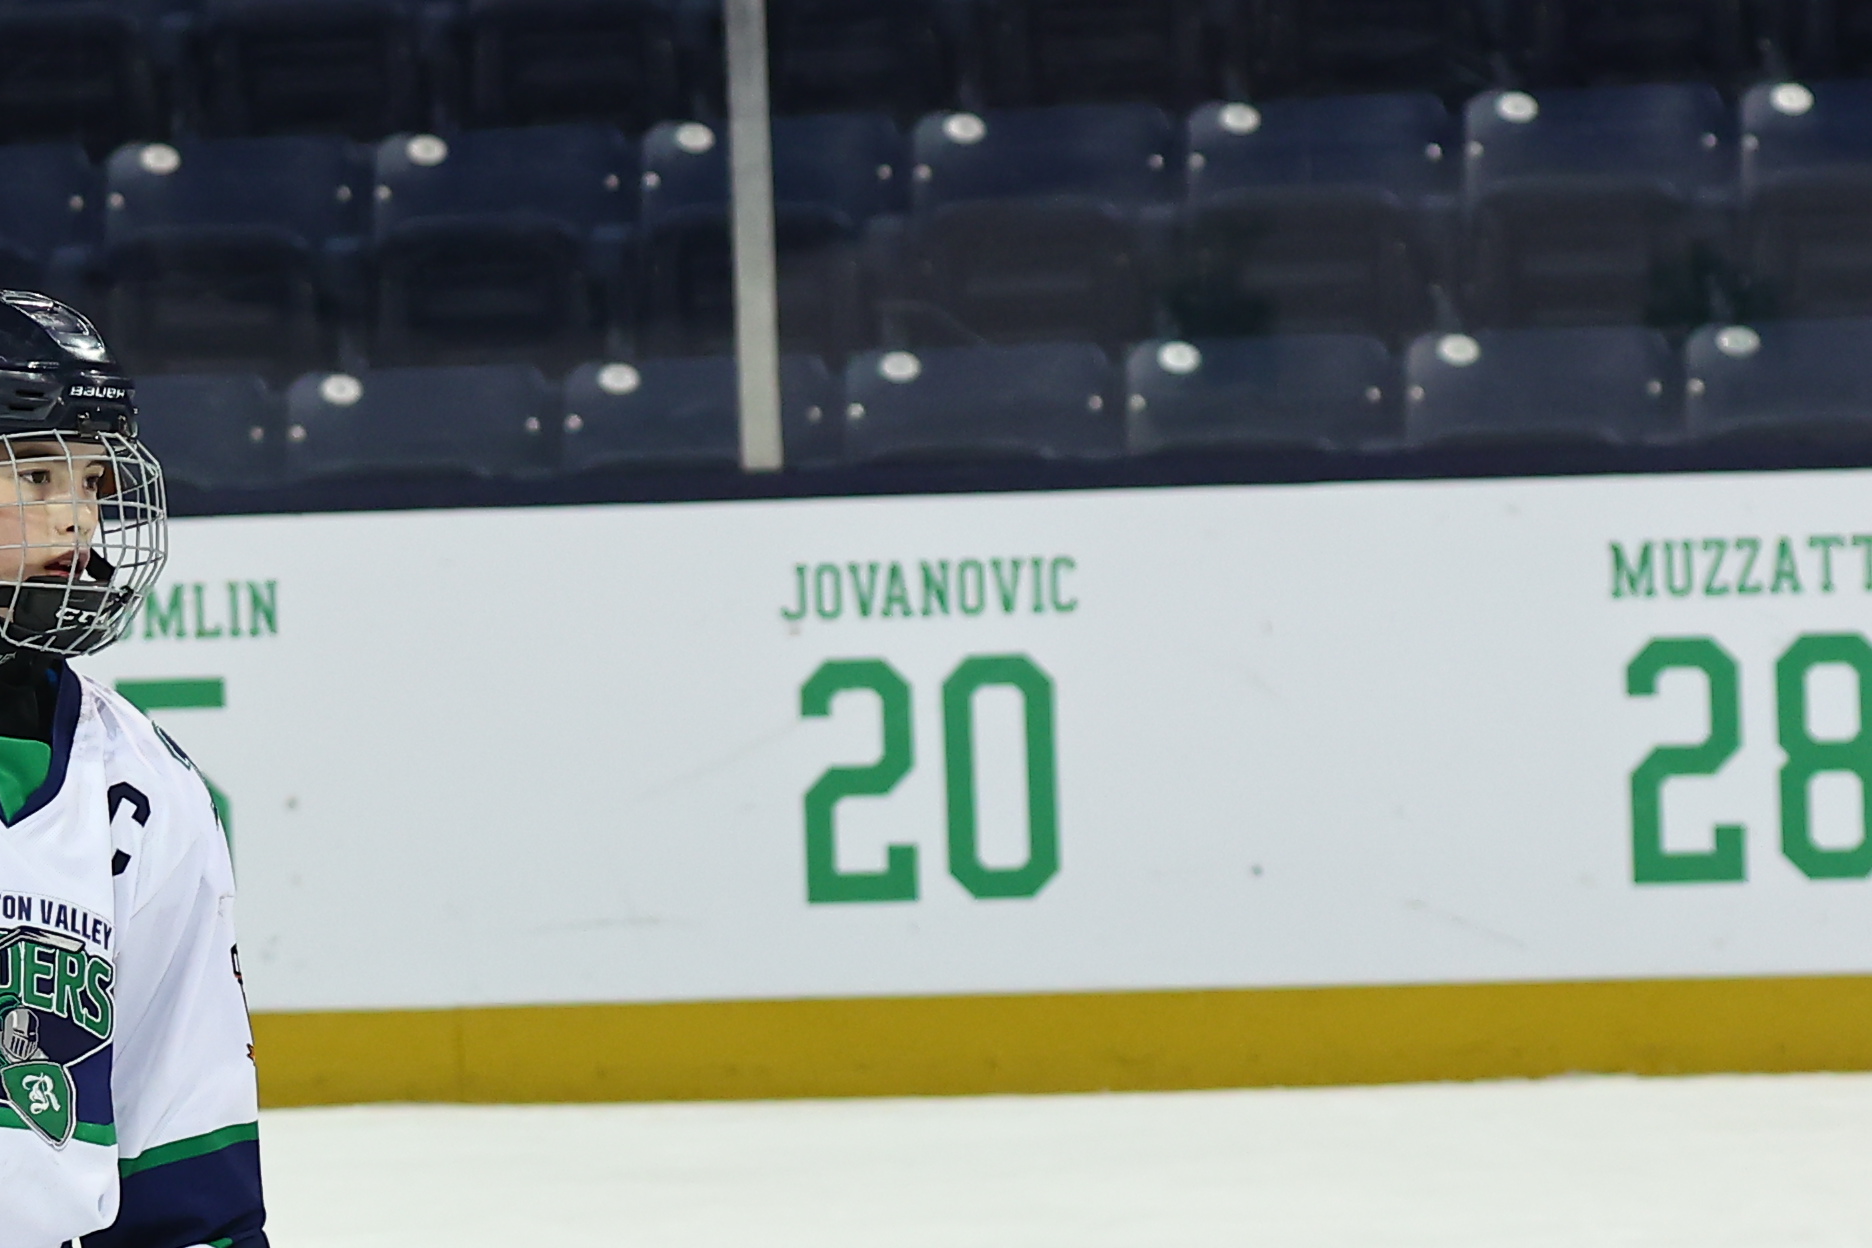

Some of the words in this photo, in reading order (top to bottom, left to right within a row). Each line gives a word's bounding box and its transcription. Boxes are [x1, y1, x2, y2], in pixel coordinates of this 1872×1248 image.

[69, 385, 126, 399] BAUER
[122, 578, 279, 640] MLIN
[780, 555, 1078, 620] JOVANOVIC
[800, 653, 1061, 903] 20
[1626, 632, 1872, 884] 28
[40, 898, 113, 951] VALLEY
